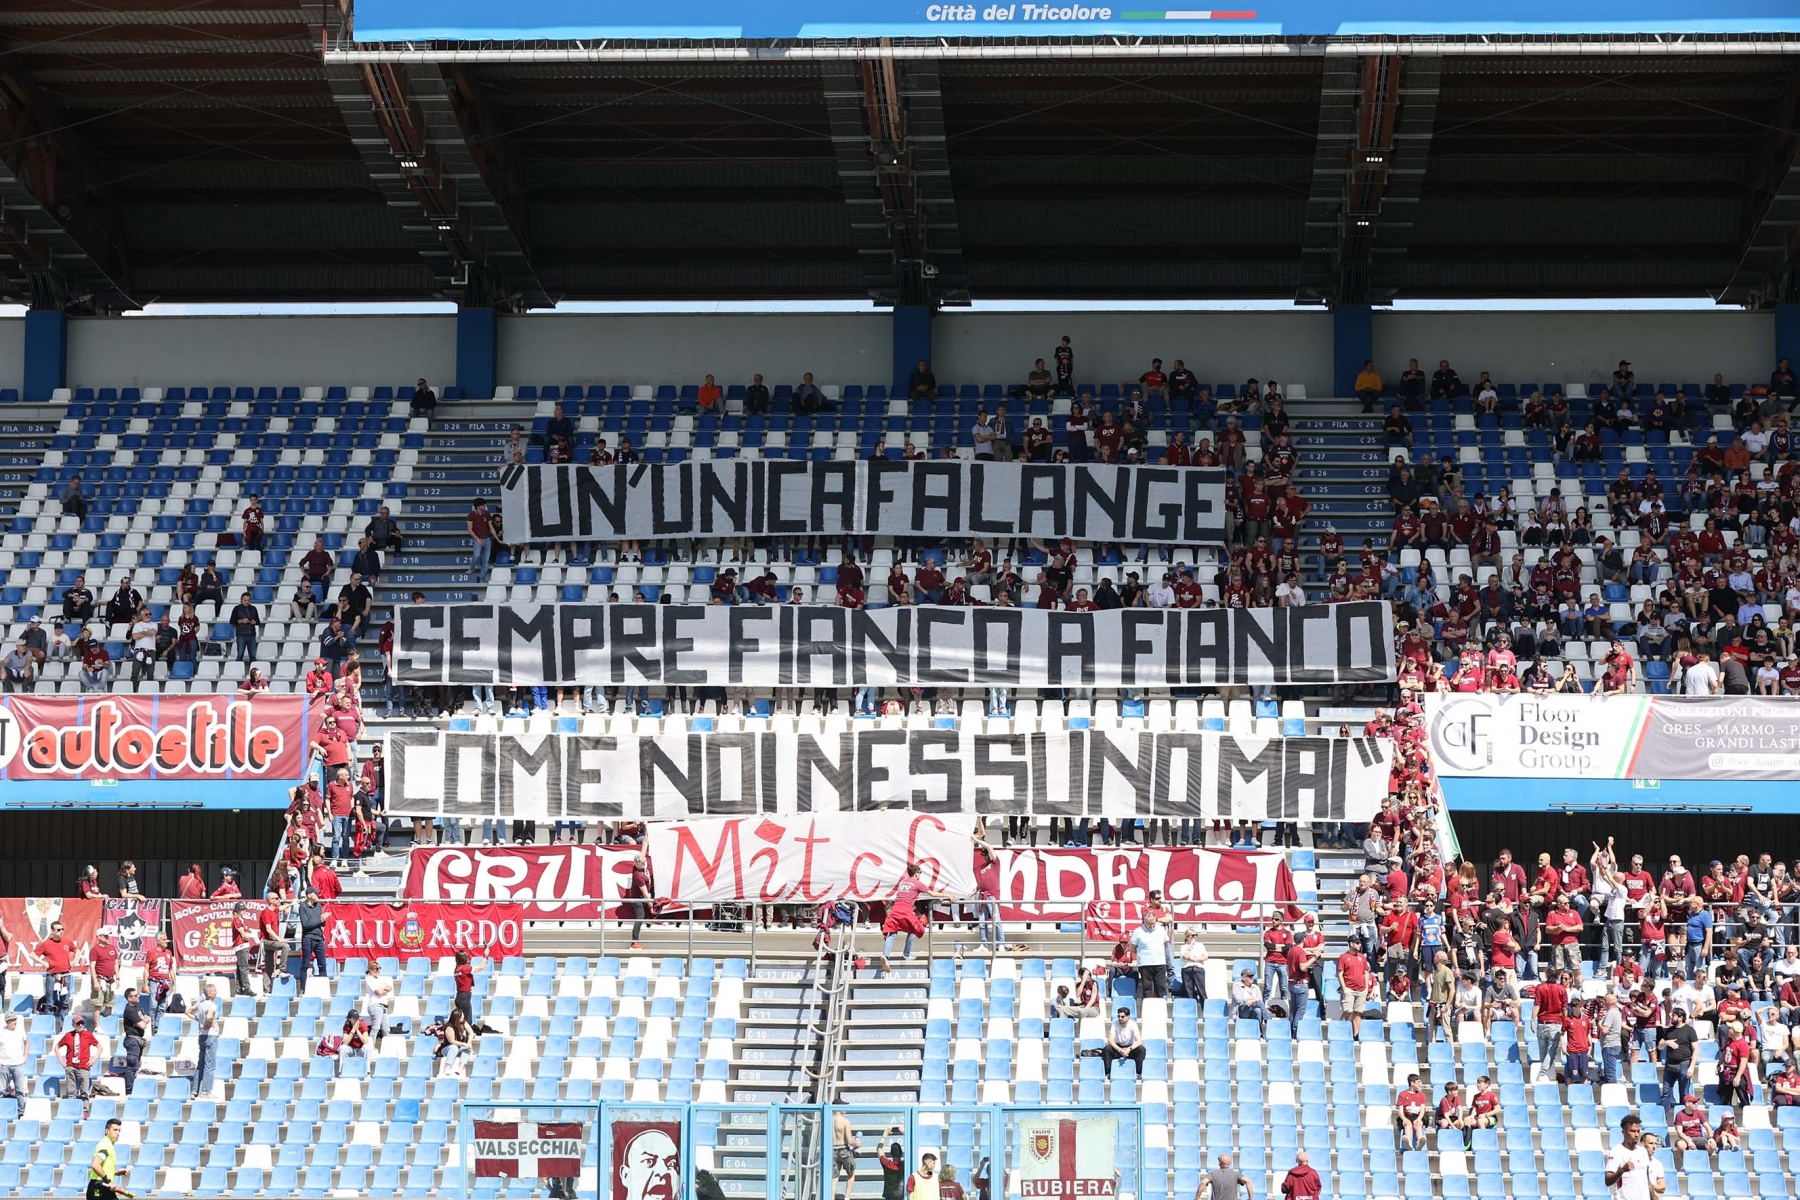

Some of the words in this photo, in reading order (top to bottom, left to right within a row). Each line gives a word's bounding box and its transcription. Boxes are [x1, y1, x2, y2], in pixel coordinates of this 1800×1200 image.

[926, 3, 976, 21] Città
[983, 3, 1014, 21] del
[1022, 3, 1112, 21] Tricolore
[866, 461, 1226, 542] FALANGE
[397, 604, 707, 684] SEMPRE
[729, 605, 1022, 684] FIANCO
[1048, 610, 1095, 685] A
[1121, 602, 1388, 685] FIANCO
[1519, 703, 1580, 723] Floor
[1663, 723, 1701, 735] GRES
[1716, 724, 1775, 735] MARMO
[1790, 724, 1800, 735] P
[24, 702, 282, 772] autostile
[1519, 726, 1600, 750] Design
[1695, 738, 1754, 749] GRANDI
[1519, 749, 1591, 774] Group
[390, 731, 623, 817] COME
[640, 732, 777, 816] NOI
[797, 730, 1203, 816] NESSUNO
[665, 814, 949, 910] Mitch
[1352, 859, 1363, 867] 05
[422, 847, 642, 912] GRUP
[996, 849, 1287, 919] NDELLI
[105, 898, 159, 910] GATTI
[1096, 902, 1111, 918] G
[174, 905, 202, 920] ROLO
[184, 930, 202, 948] G
[328, 919, 396, 948] ALU
[428, 919, 519, 950] ARDO
[183, 954, 215, 963] BASSA
[767, 971, 777, 979] 13
[782, 971, 801, 979] FILA
[915, 971, 926, 979] 13
[764, 991, 774, 999] 12
[913, 991, 924, 999] 12
[757, 1031, 767, 1039] 10
[906, 1052, 918, 1060] 09
[749, 1072, 760, 1080] 08
[904, 1072, 916, 1081] 08
[742, 1115, 753, 1123] 06
[477, 1140, 580, 1156] VALSECCHIA
[738, 1138, 749, 1146] 05
[734, 1160, 746, 1168] 04
[730, 1183, 742, 1191] 03
[1022, 1180, 1114, 1195] RUBIERA
